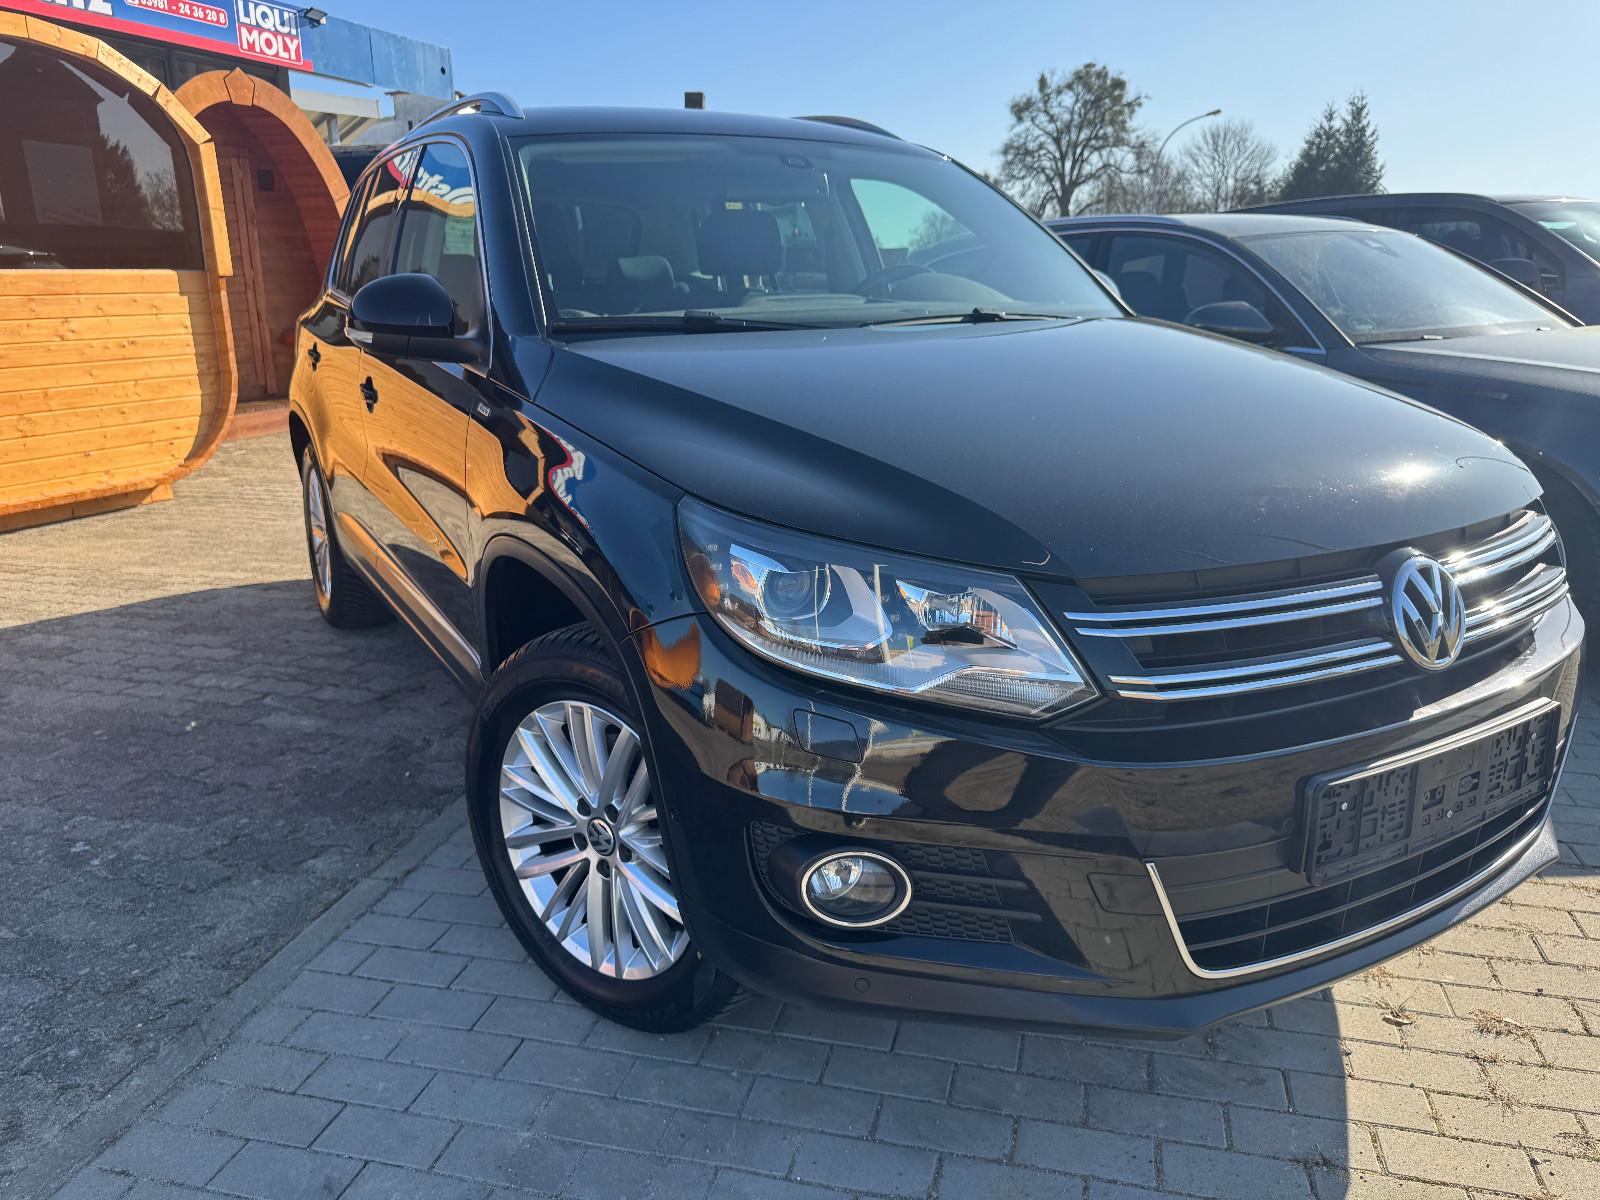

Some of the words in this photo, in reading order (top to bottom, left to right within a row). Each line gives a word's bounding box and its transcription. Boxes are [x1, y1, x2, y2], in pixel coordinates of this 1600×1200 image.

[178, 3, 191, 15] 24
[192, 6, 204, 18] 36
[205, 9, 217, 21] 20
[219, 13, 226, 24] 8
[238, 0, 297, 35] LIQUI
[240, 26, 299, 60] MOLY
